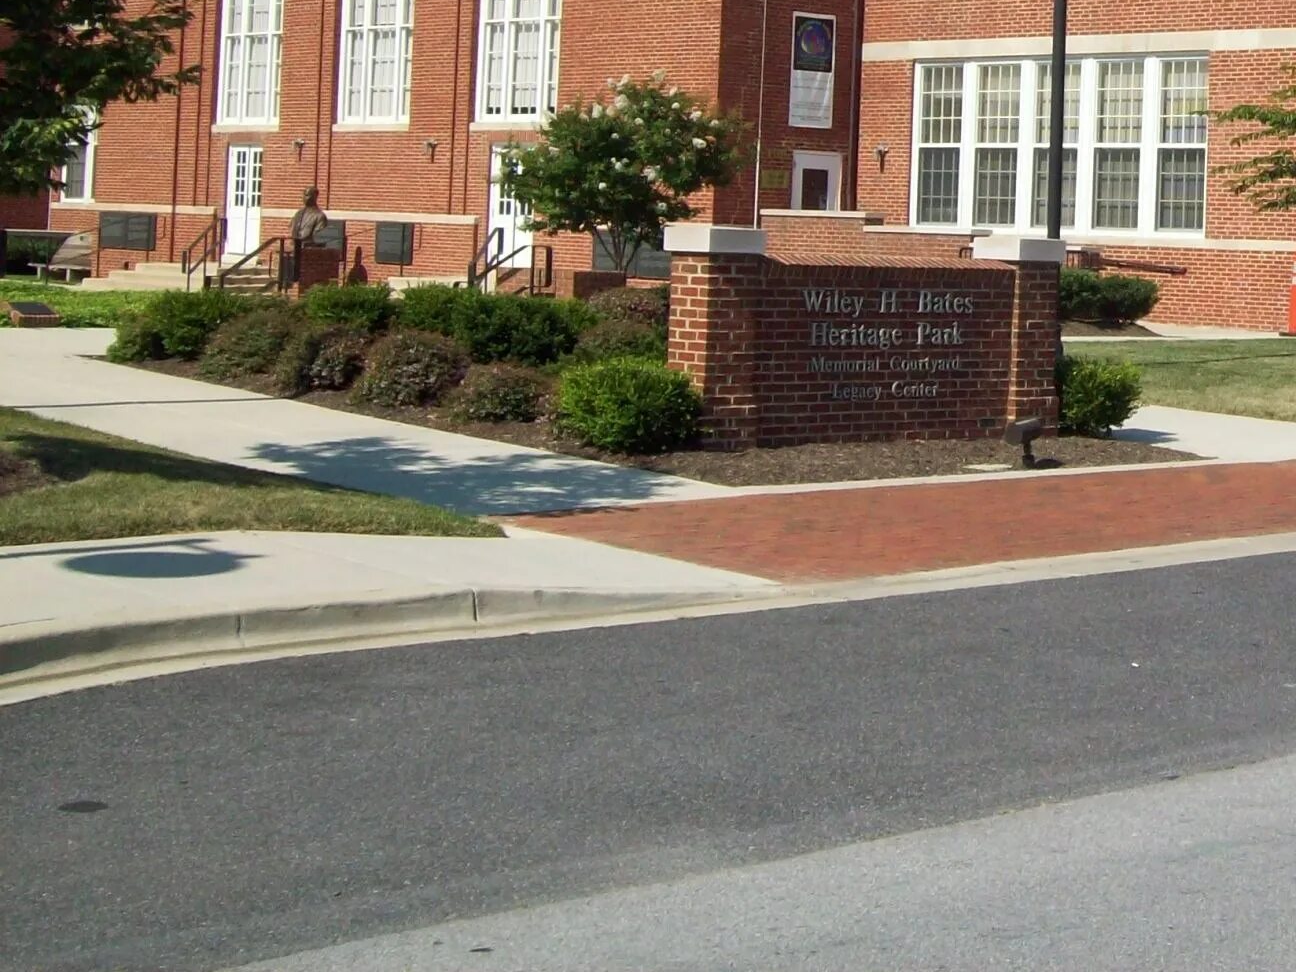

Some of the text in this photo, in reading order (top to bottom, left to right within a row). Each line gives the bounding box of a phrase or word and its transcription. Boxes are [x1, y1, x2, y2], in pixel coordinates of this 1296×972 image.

[803, 290, 974, 317] Wiley H. Bates
[810, 322, 963, 349] Heritage Park
[809, 356, 960, 374] Memorial Courtyard
[832, 381, 939, 400] Legacy Center
